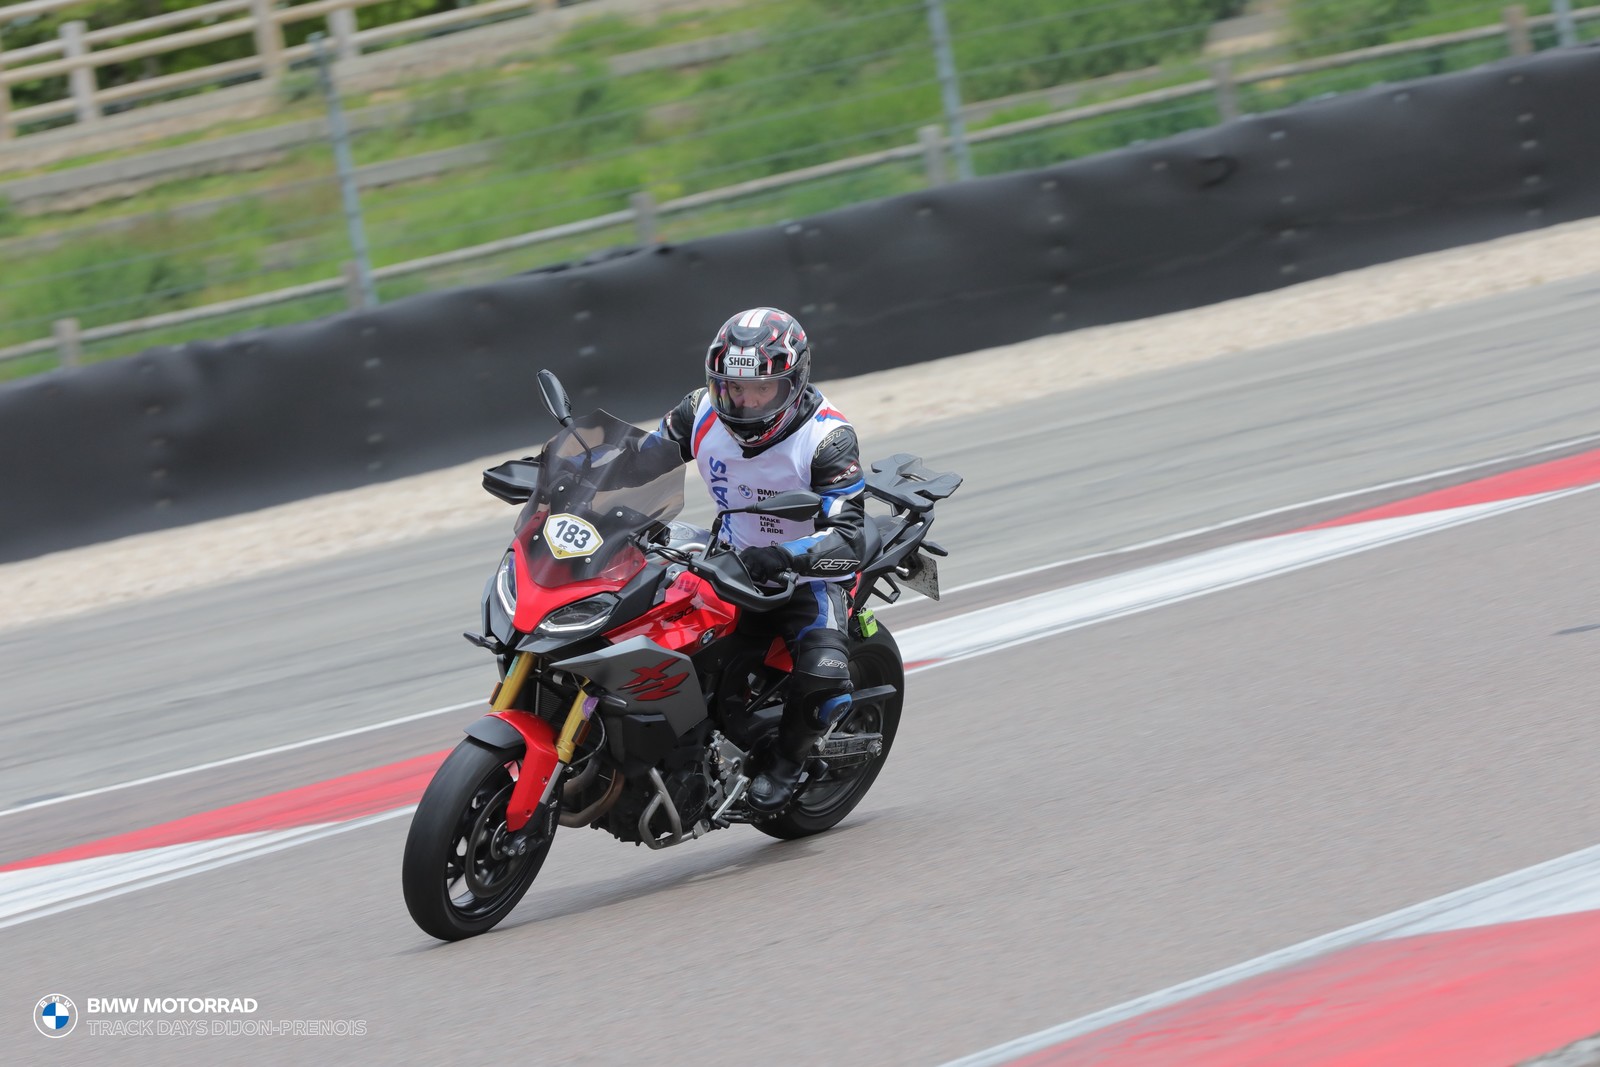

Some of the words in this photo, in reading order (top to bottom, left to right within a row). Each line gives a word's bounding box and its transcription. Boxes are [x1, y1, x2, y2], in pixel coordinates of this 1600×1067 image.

[728, 356, 755, 367] SHOEI
[815, 428, 845, 458] RST
[759, 515, 781, 524] MAKE
[555, 519, 592, 549] 183
[812, 559, 860, 570] RST
[817, 658, 848, 669] RST
